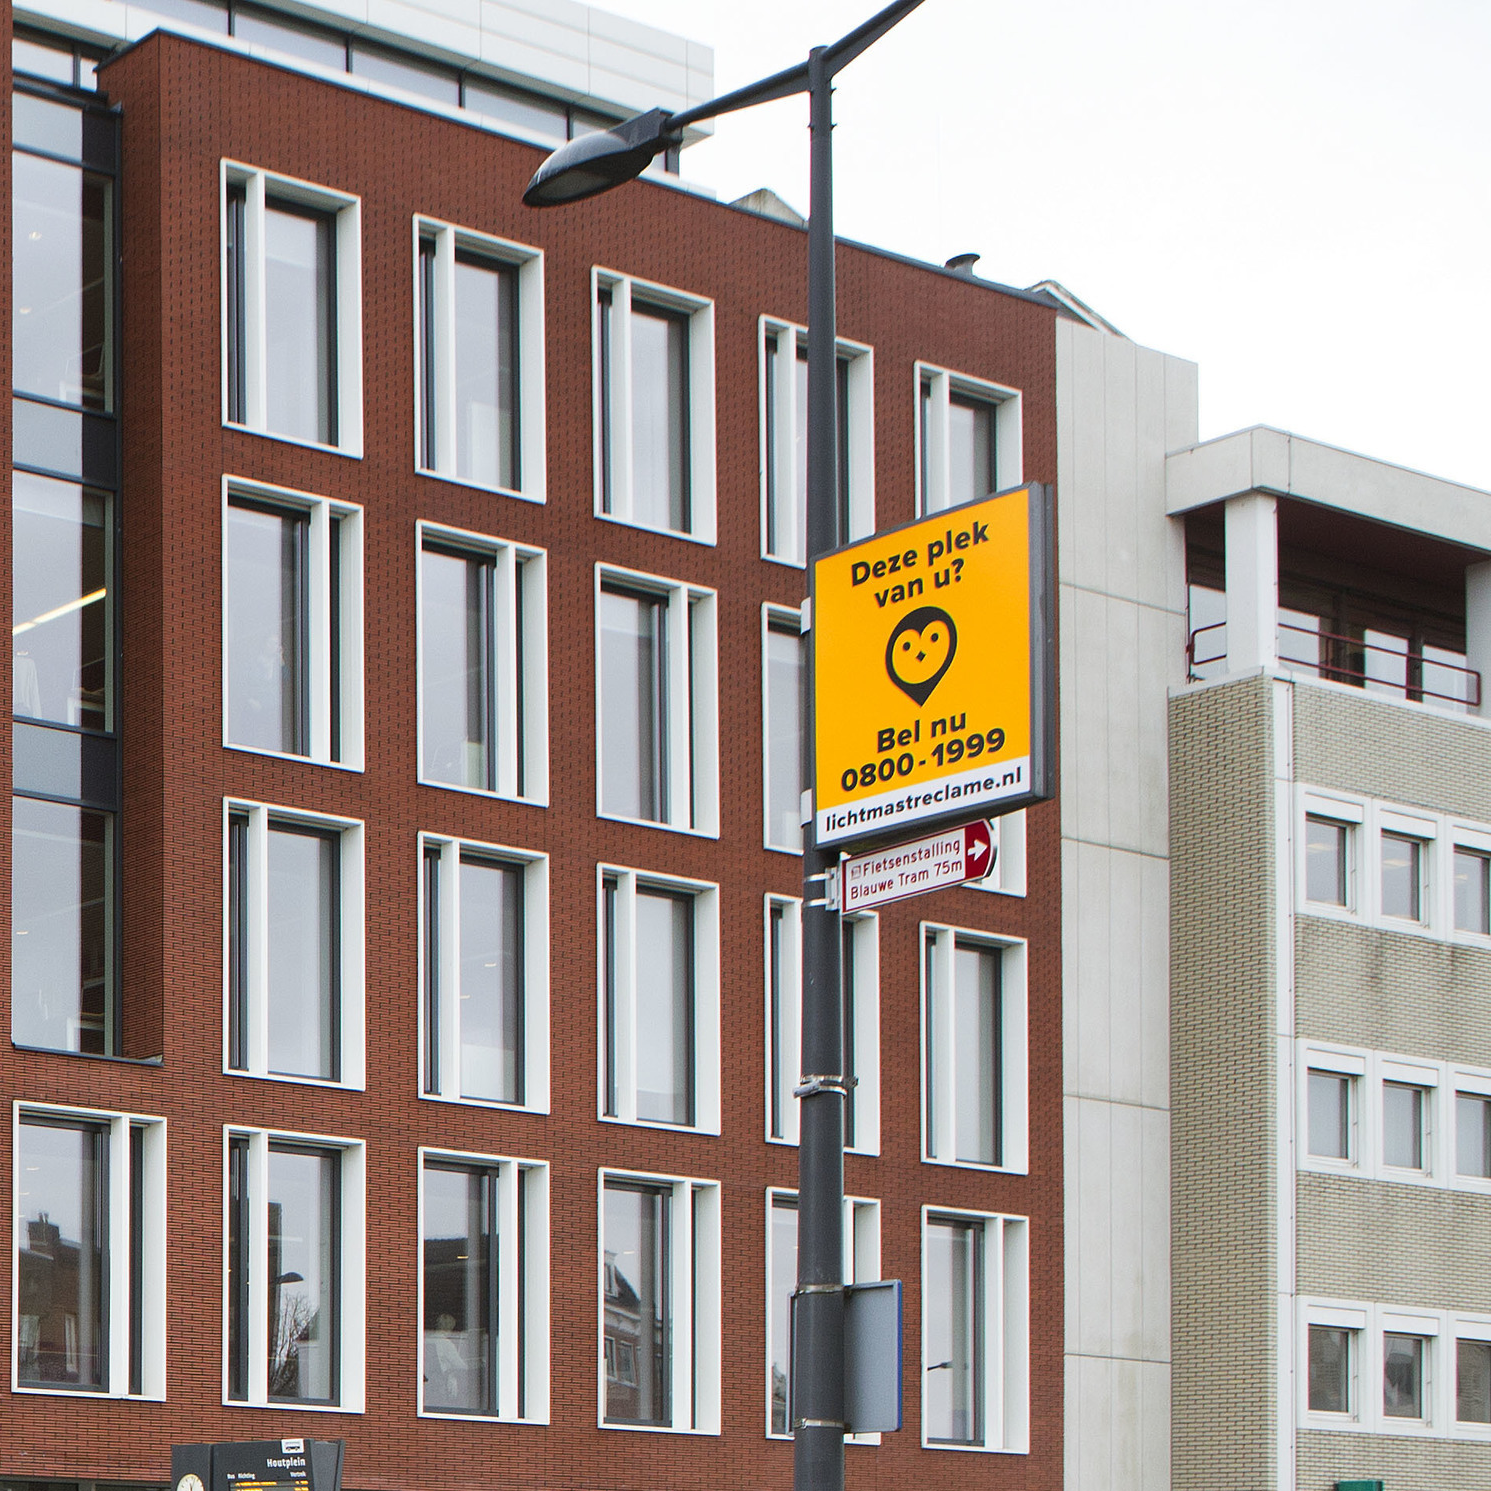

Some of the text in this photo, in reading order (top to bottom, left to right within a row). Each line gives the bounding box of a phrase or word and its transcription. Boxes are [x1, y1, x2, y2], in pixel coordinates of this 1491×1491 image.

[850, 521, 990, 587] Deze plek
[874, 558, 964, 608] van u?
[876, 712, 967, 753] Bel nu
[825, 766, 1022, 832] lichtmastreclame.nl
[863, 838, 961, 877] Fietsenstalling
[850, 859, 963, 900] Blauwe Tram 75m
[266, 1457, 306, 1469] Houtplein
